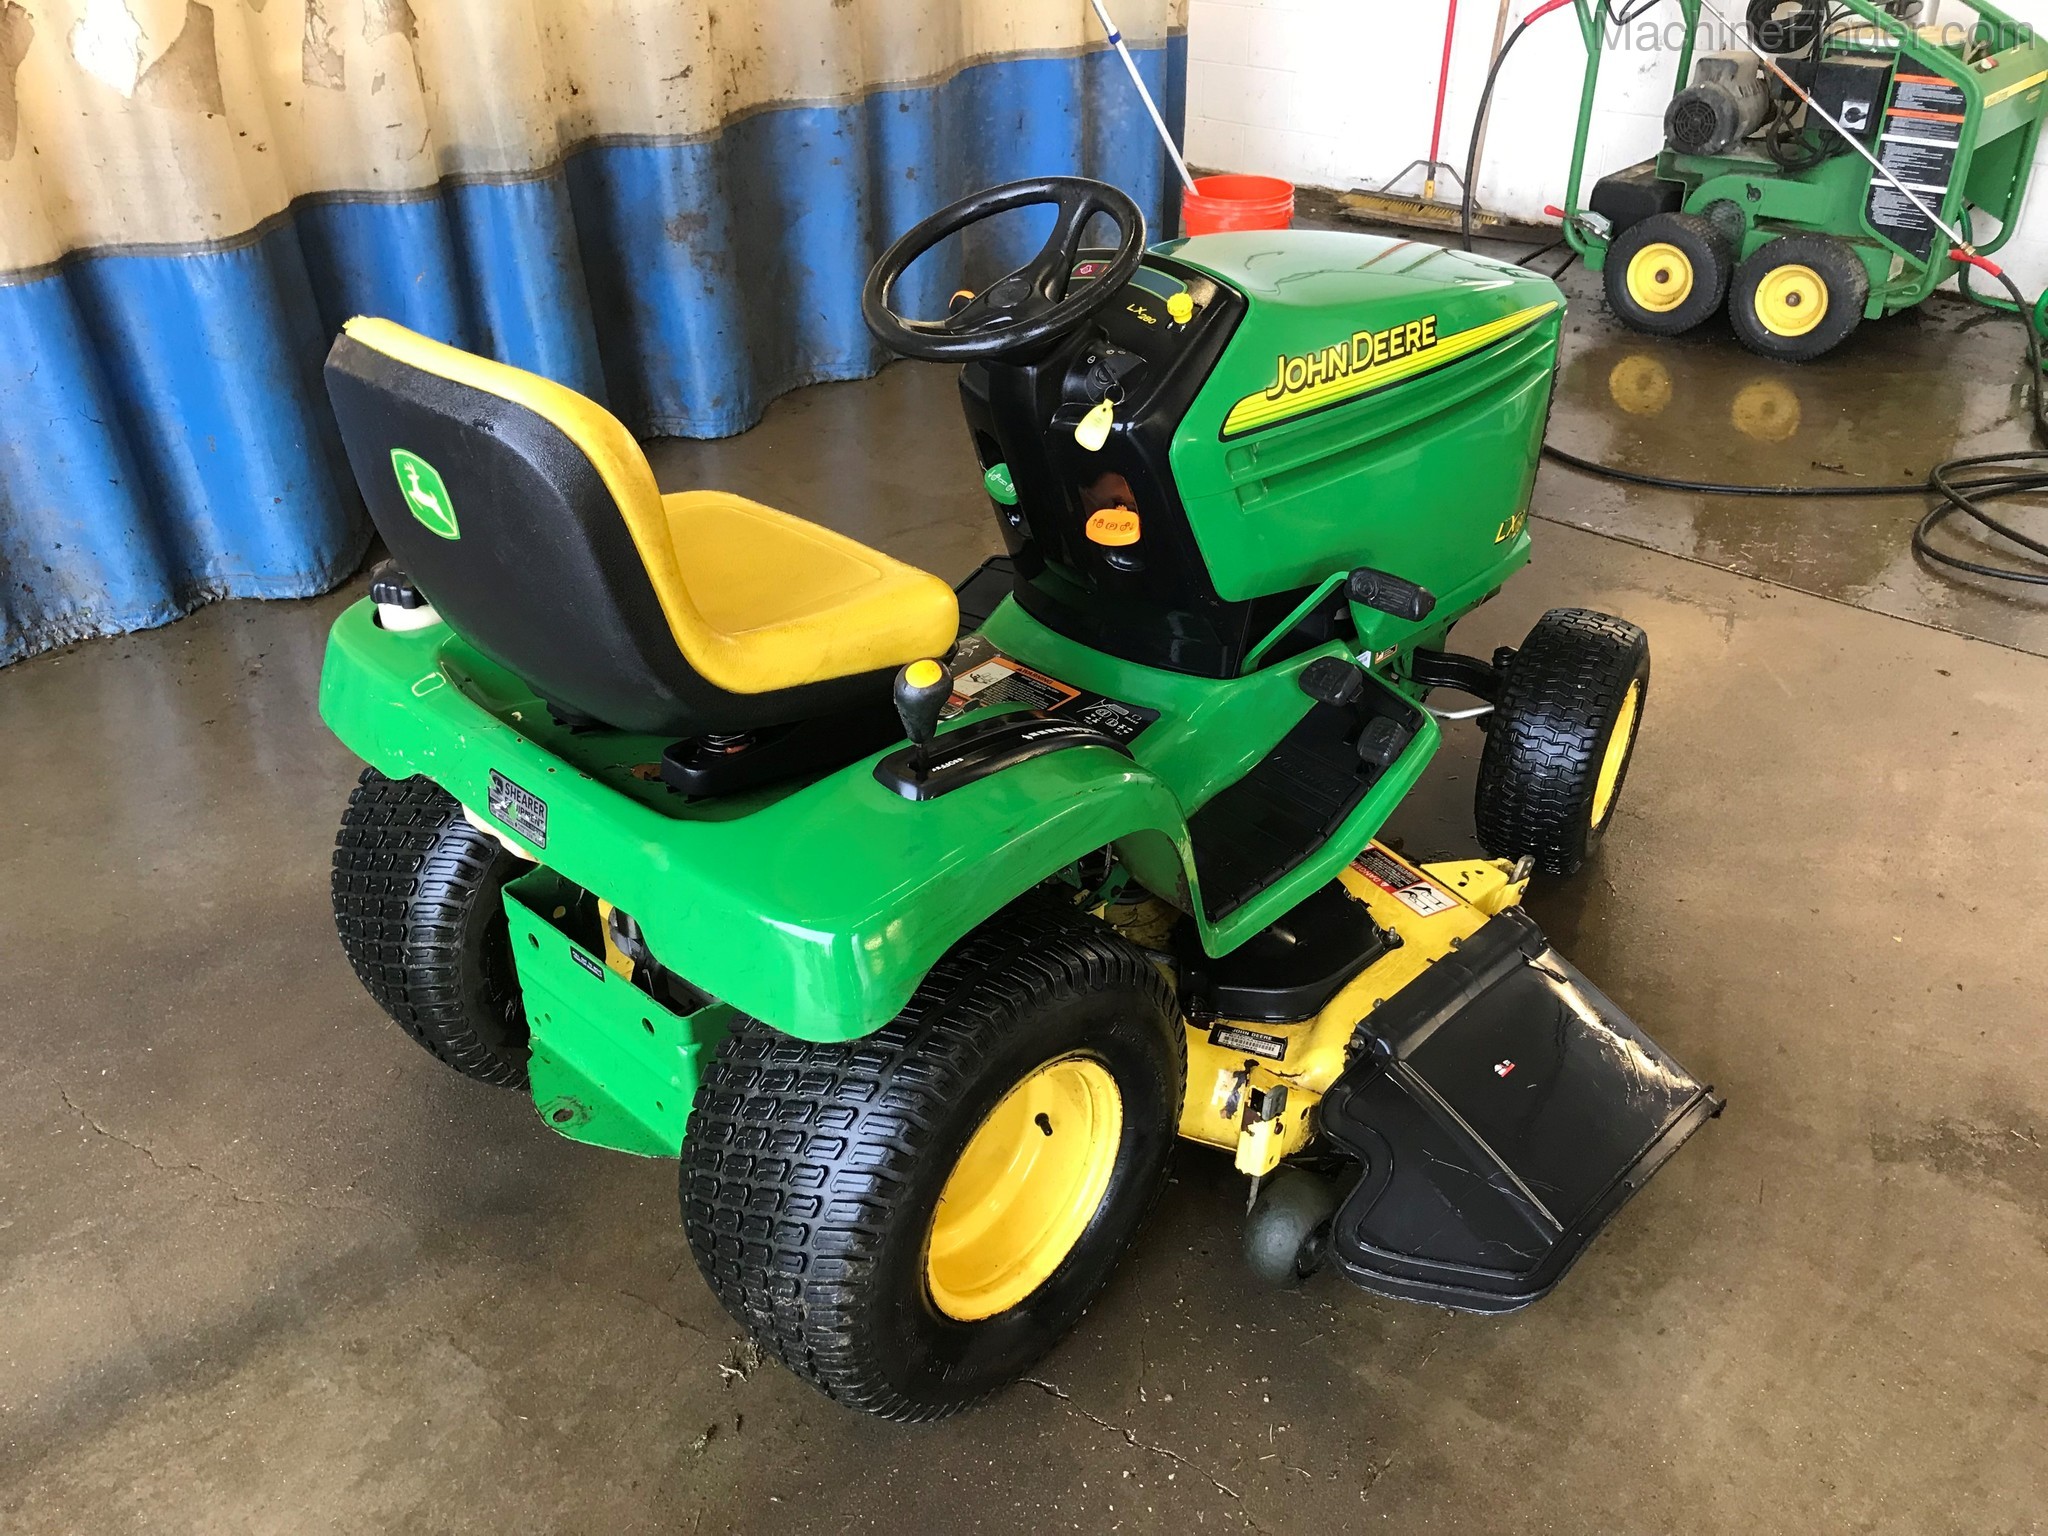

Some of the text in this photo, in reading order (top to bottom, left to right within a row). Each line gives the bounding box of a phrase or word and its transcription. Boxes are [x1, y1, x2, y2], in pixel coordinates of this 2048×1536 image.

[1266, 314, 1437, 401] JOHN DEERE
[505, 783, 545, 818] SHEARER
